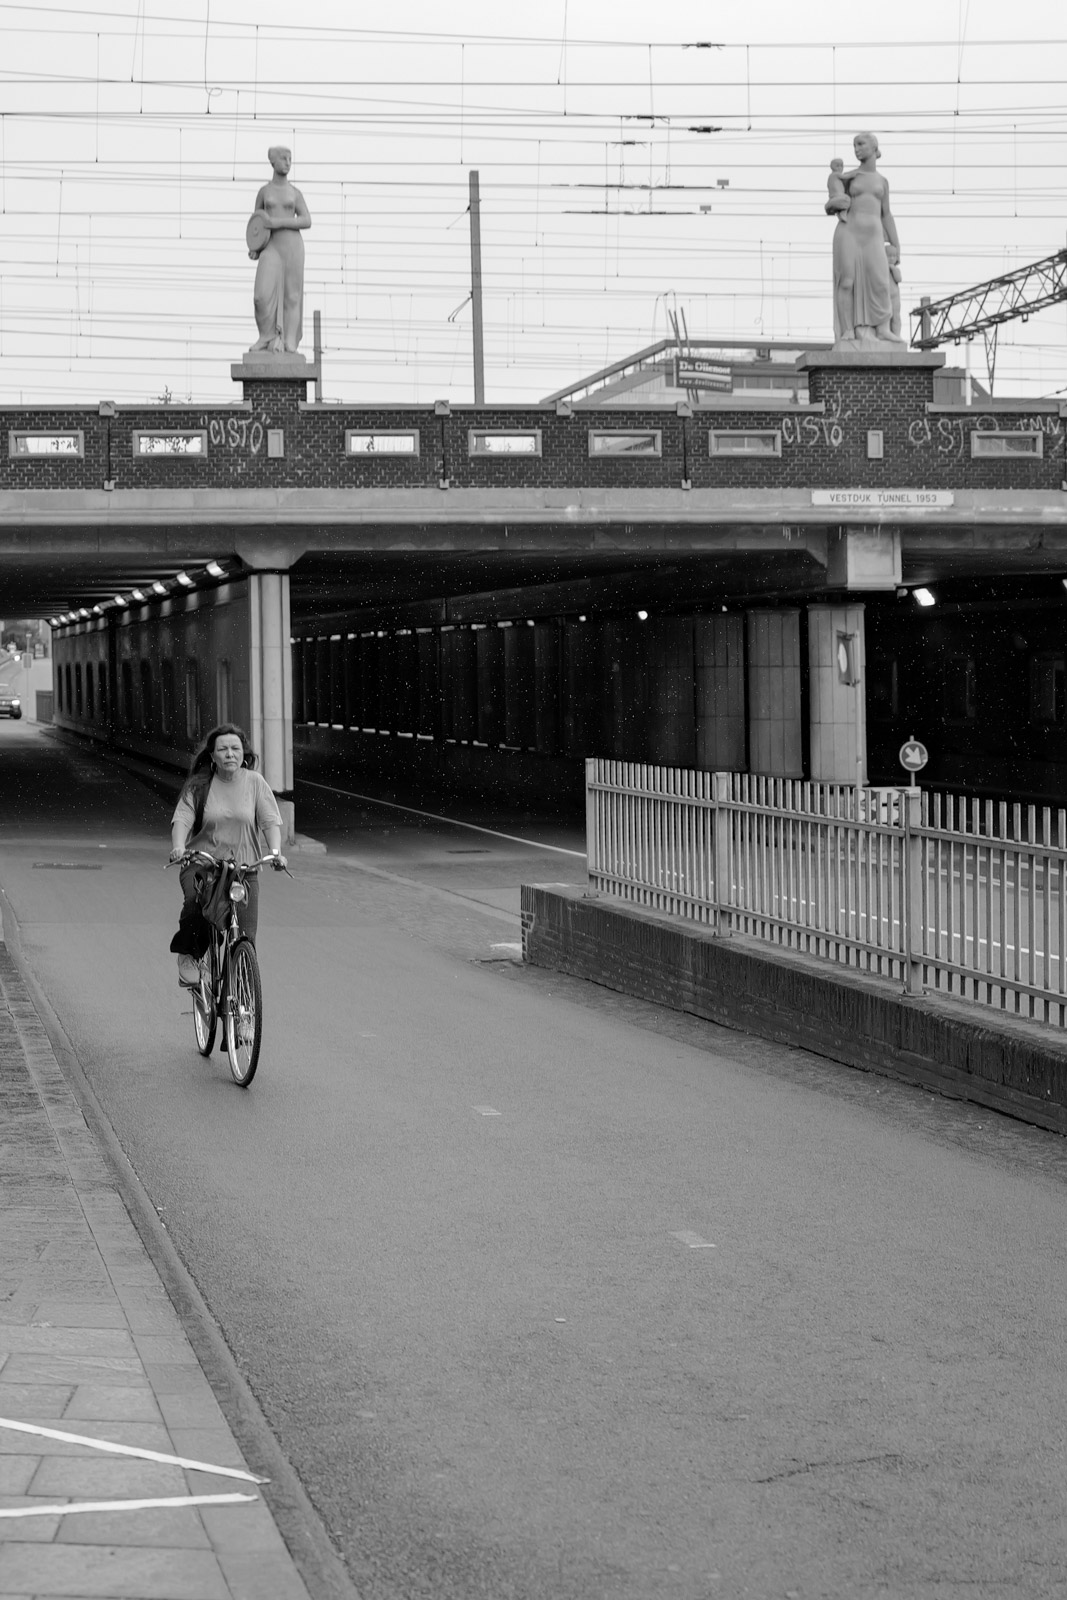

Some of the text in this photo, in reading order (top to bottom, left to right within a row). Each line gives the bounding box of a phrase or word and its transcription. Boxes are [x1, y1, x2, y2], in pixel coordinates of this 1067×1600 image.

[679, 361, 694, 370] De
[877, 493, 912, 503] TUNNEL
[915, 494, 937, 503] 1953
